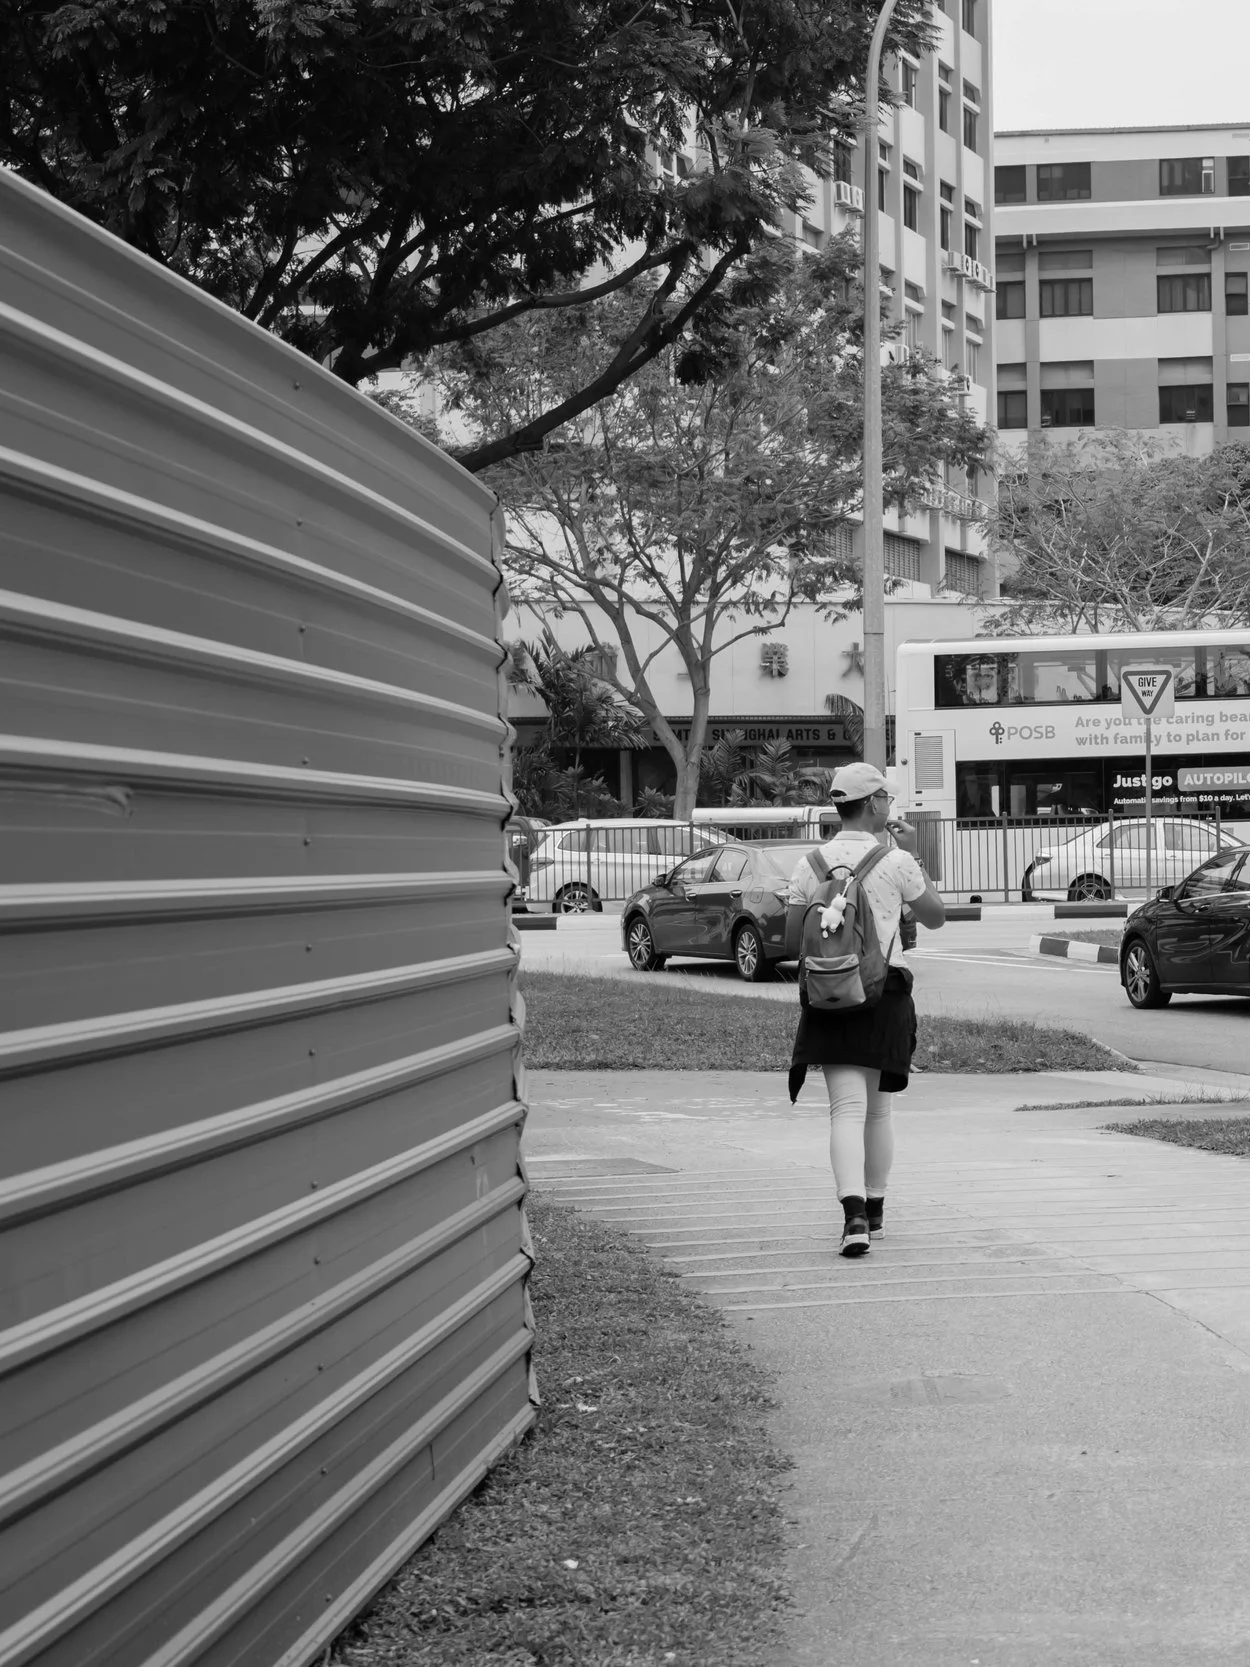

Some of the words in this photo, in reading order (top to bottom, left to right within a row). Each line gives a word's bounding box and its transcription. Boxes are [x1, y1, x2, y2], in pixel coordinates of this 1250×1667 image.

[1138, 676, 1157, 688] GIVE
[1075, 716, 1100, 728] Are
[1105, 718, 1133, 730] you
[1166, 712, 1214, 726] caring
[786, 728, 820, 740] ARTS
[828, 729, 836, 740] &
[1007, 725, 1056, 740] POSB
[1075, 733, 1109, 746] with
[1114, 732, 1162, 746] famiy
[1166, 731, 1182, 742] to
[1186, 730, 1220, 745] plan
[1224, 728, 1246, 741] for
[1113, 774, 1146, 788] Just
[1152, 776, 1172, 790] go
[1114, 796, 1146, 804] Automati
[1152, 796, 1178, 804] savings
[1199, 794, 1212, 802] $10
[1220, 794, 1235, 802] day.
